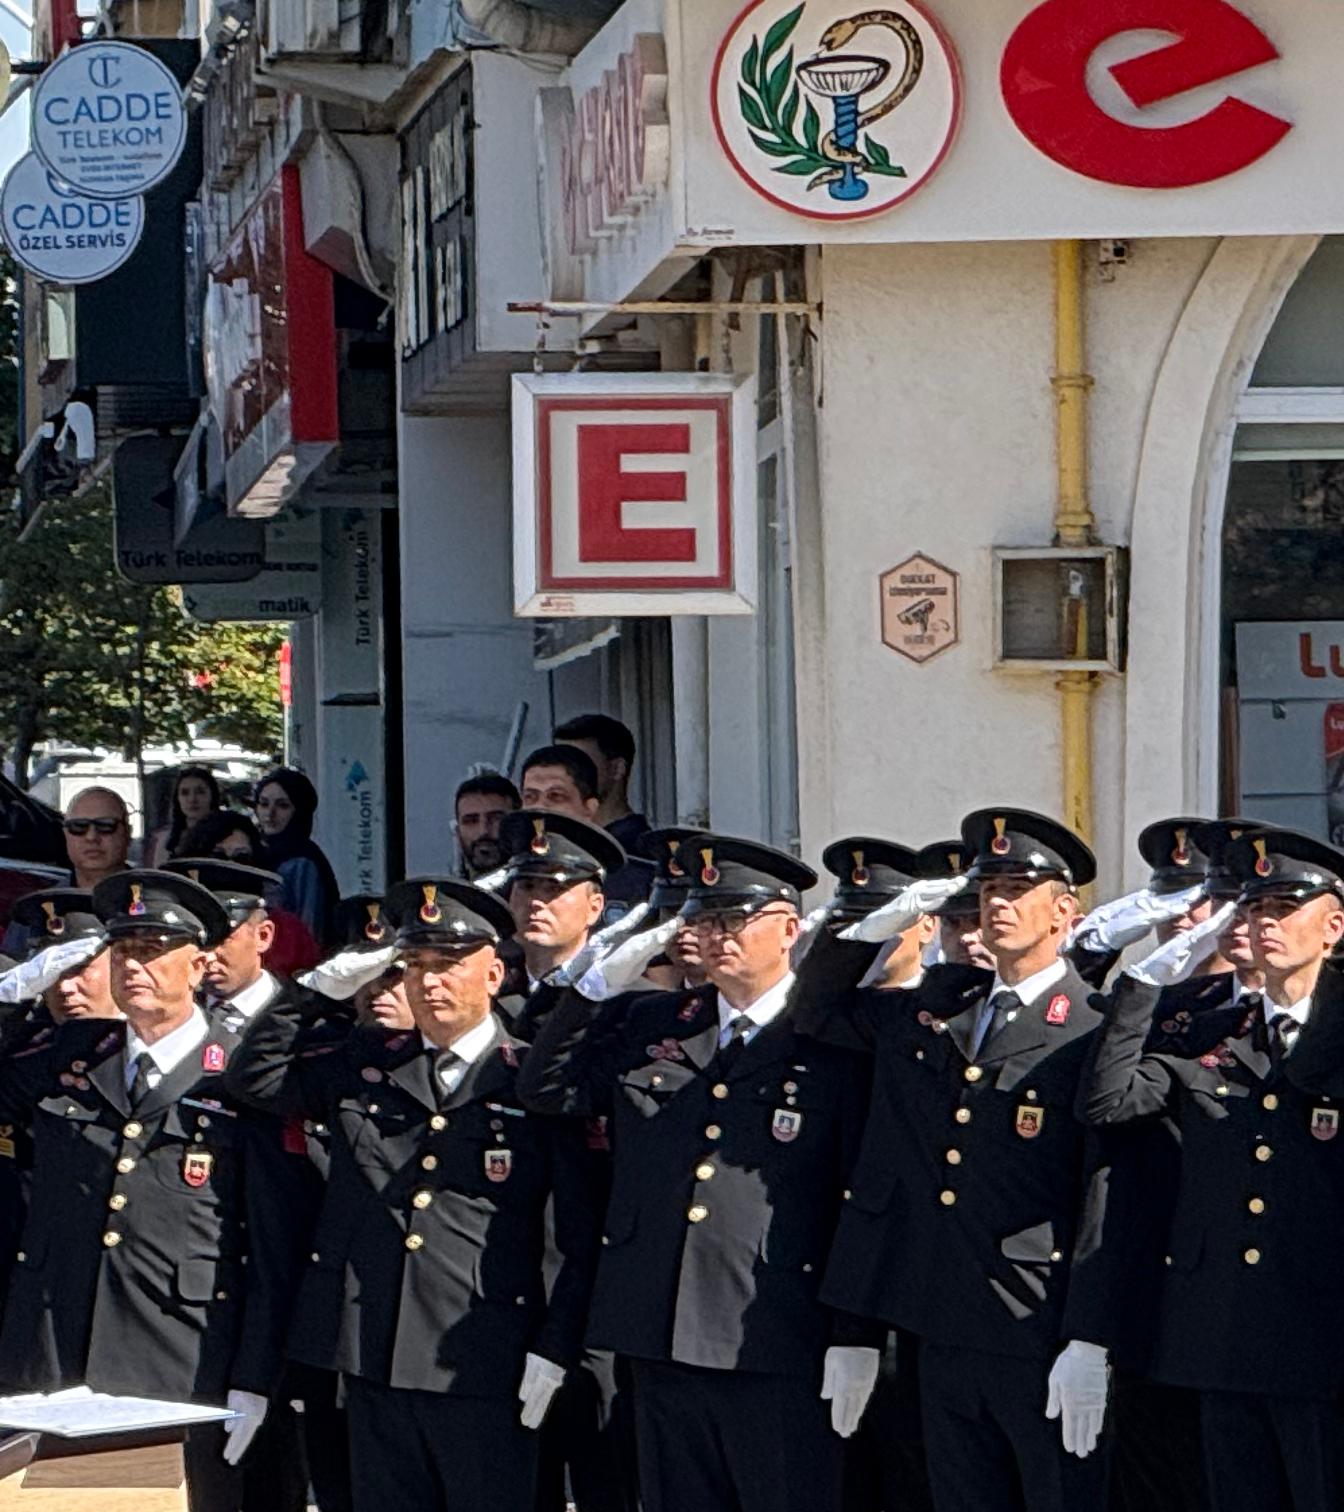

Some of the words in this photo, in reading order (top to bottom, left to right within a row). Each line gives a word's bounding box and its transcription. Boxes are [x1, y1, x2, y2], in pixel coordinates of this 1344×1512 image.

[44, 91, 173, 125] CADDE
[57, 127, 163, 150] TELEKOM
[12, 200, 131, 231] CADDE
[18, 234, 65, 251] ÖZEL
[66, 228, 127, 250] SERVİS
[577, 423, 696, 562] E
[121, 550, 167, 569] Türk
[174, 549, 261, 569] Telekom
[357, 790, 373, 862] Telekom
